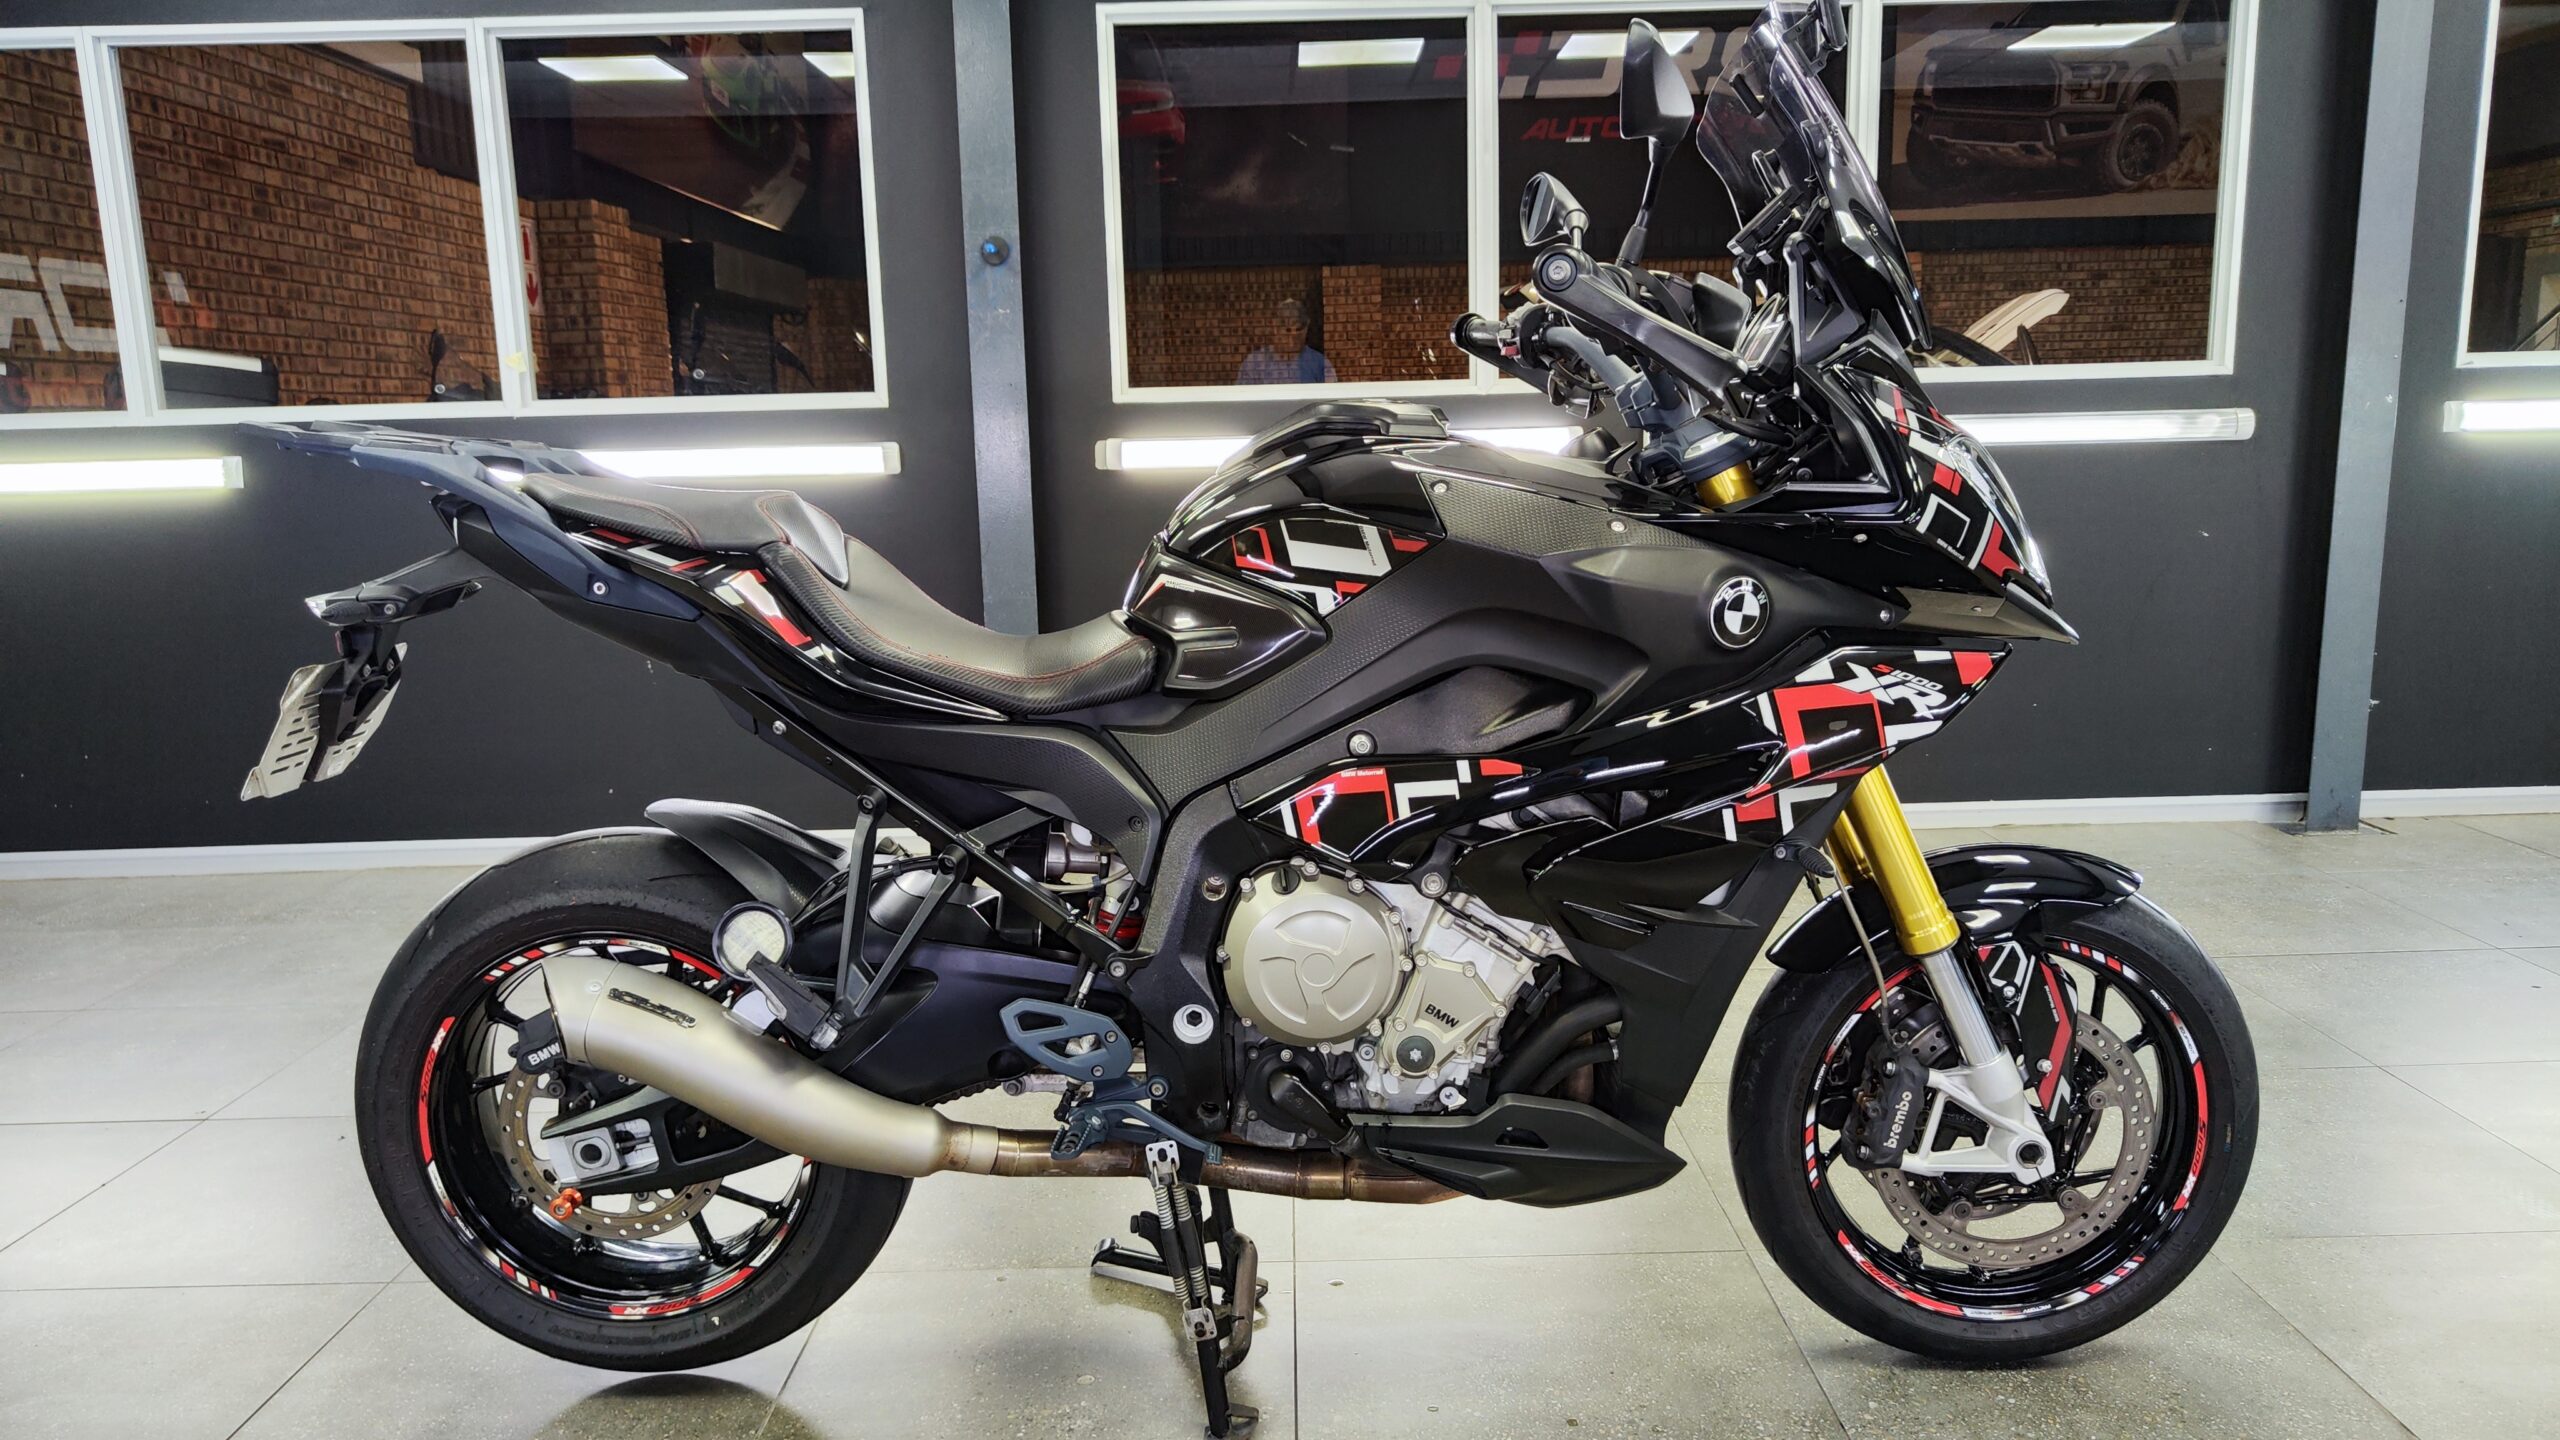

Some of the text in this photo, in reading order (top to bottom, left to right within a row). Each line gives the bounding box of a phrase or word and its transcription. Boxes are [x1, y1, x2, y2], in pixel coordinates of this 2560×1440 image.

[1723, 579, 1767, 606] BMW
[1424, 1003, 1460, 1028] BMW
[527, 1042, 561, 1066] BMW
[1883, 1091, 1913, 1149] brembo
